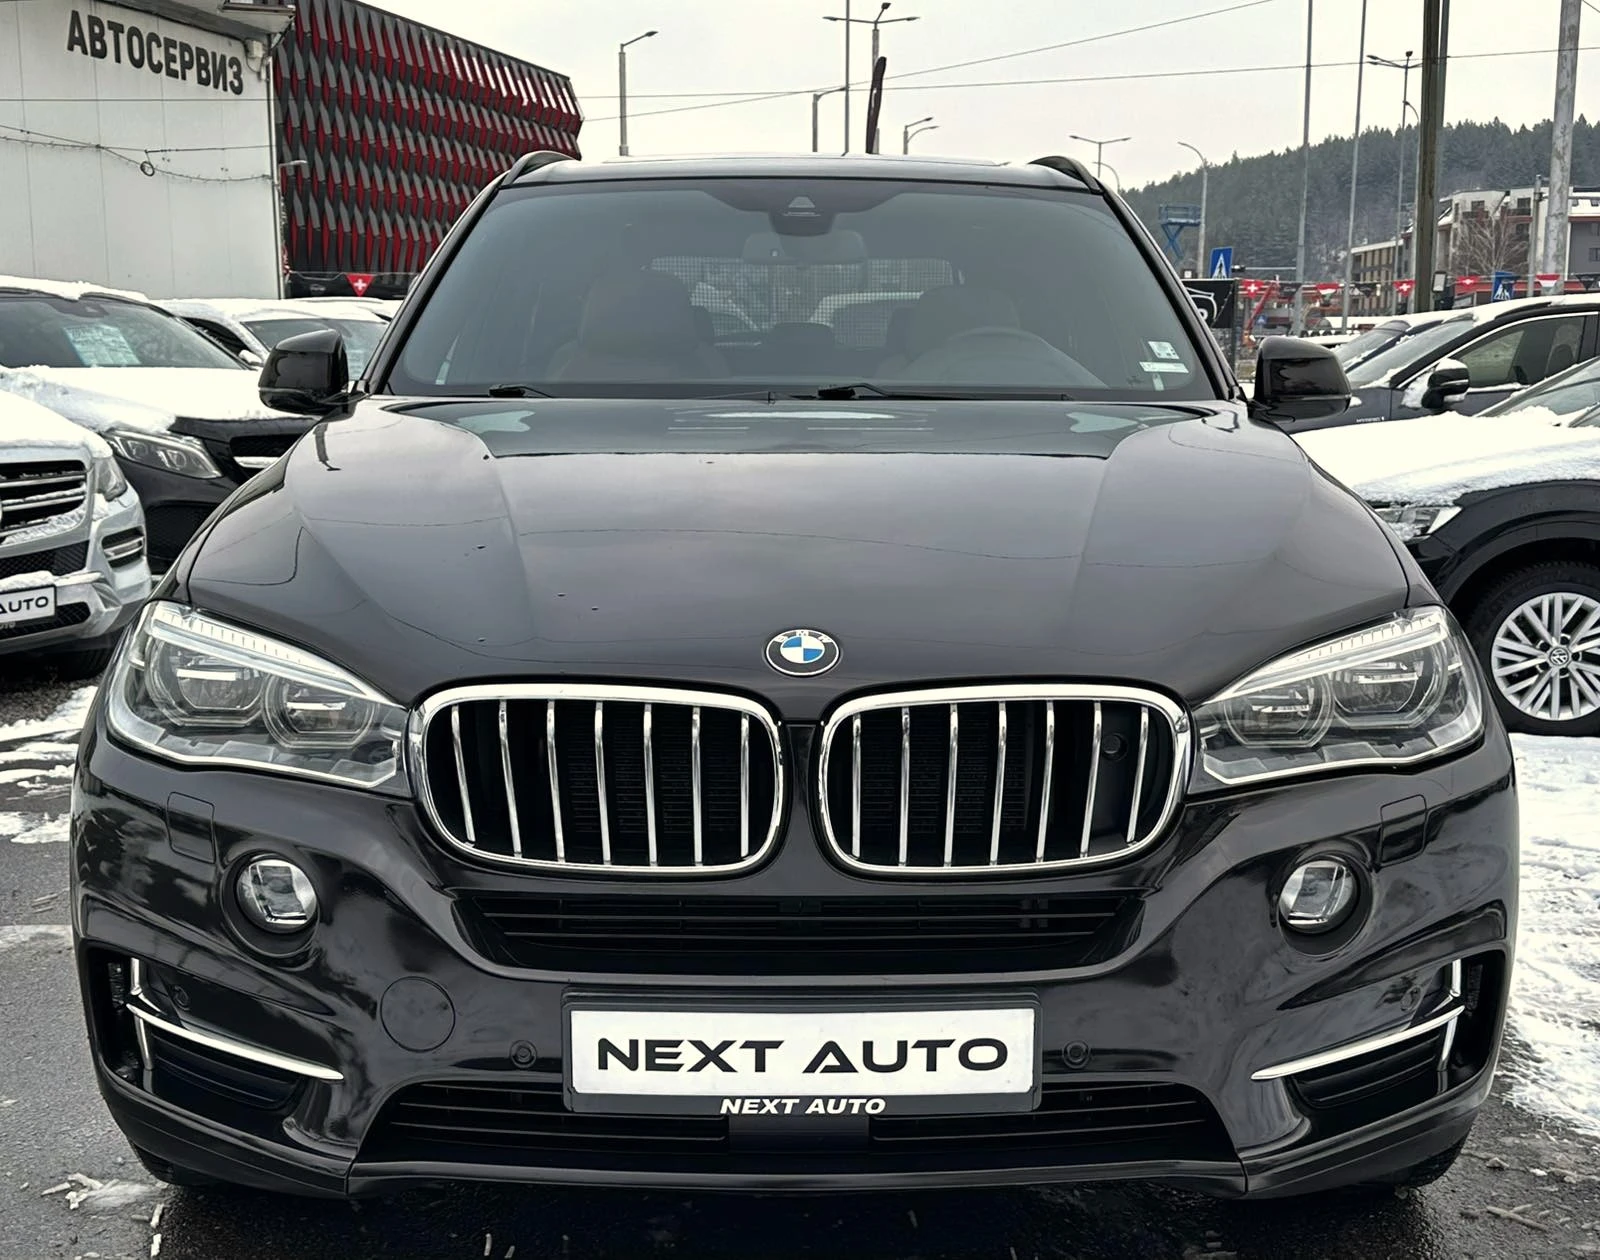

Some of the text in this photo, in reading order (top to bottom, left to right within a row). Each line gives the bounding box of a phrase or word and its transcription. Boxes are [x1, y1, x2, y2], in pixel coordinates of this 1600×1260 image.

[67, 10, 243, 95] АВТОСЕРВИЗ
[597, 1037, 1008, 1074] NEXT AUTO
[720, 1098, 886, 1115] NEXT AUTO
